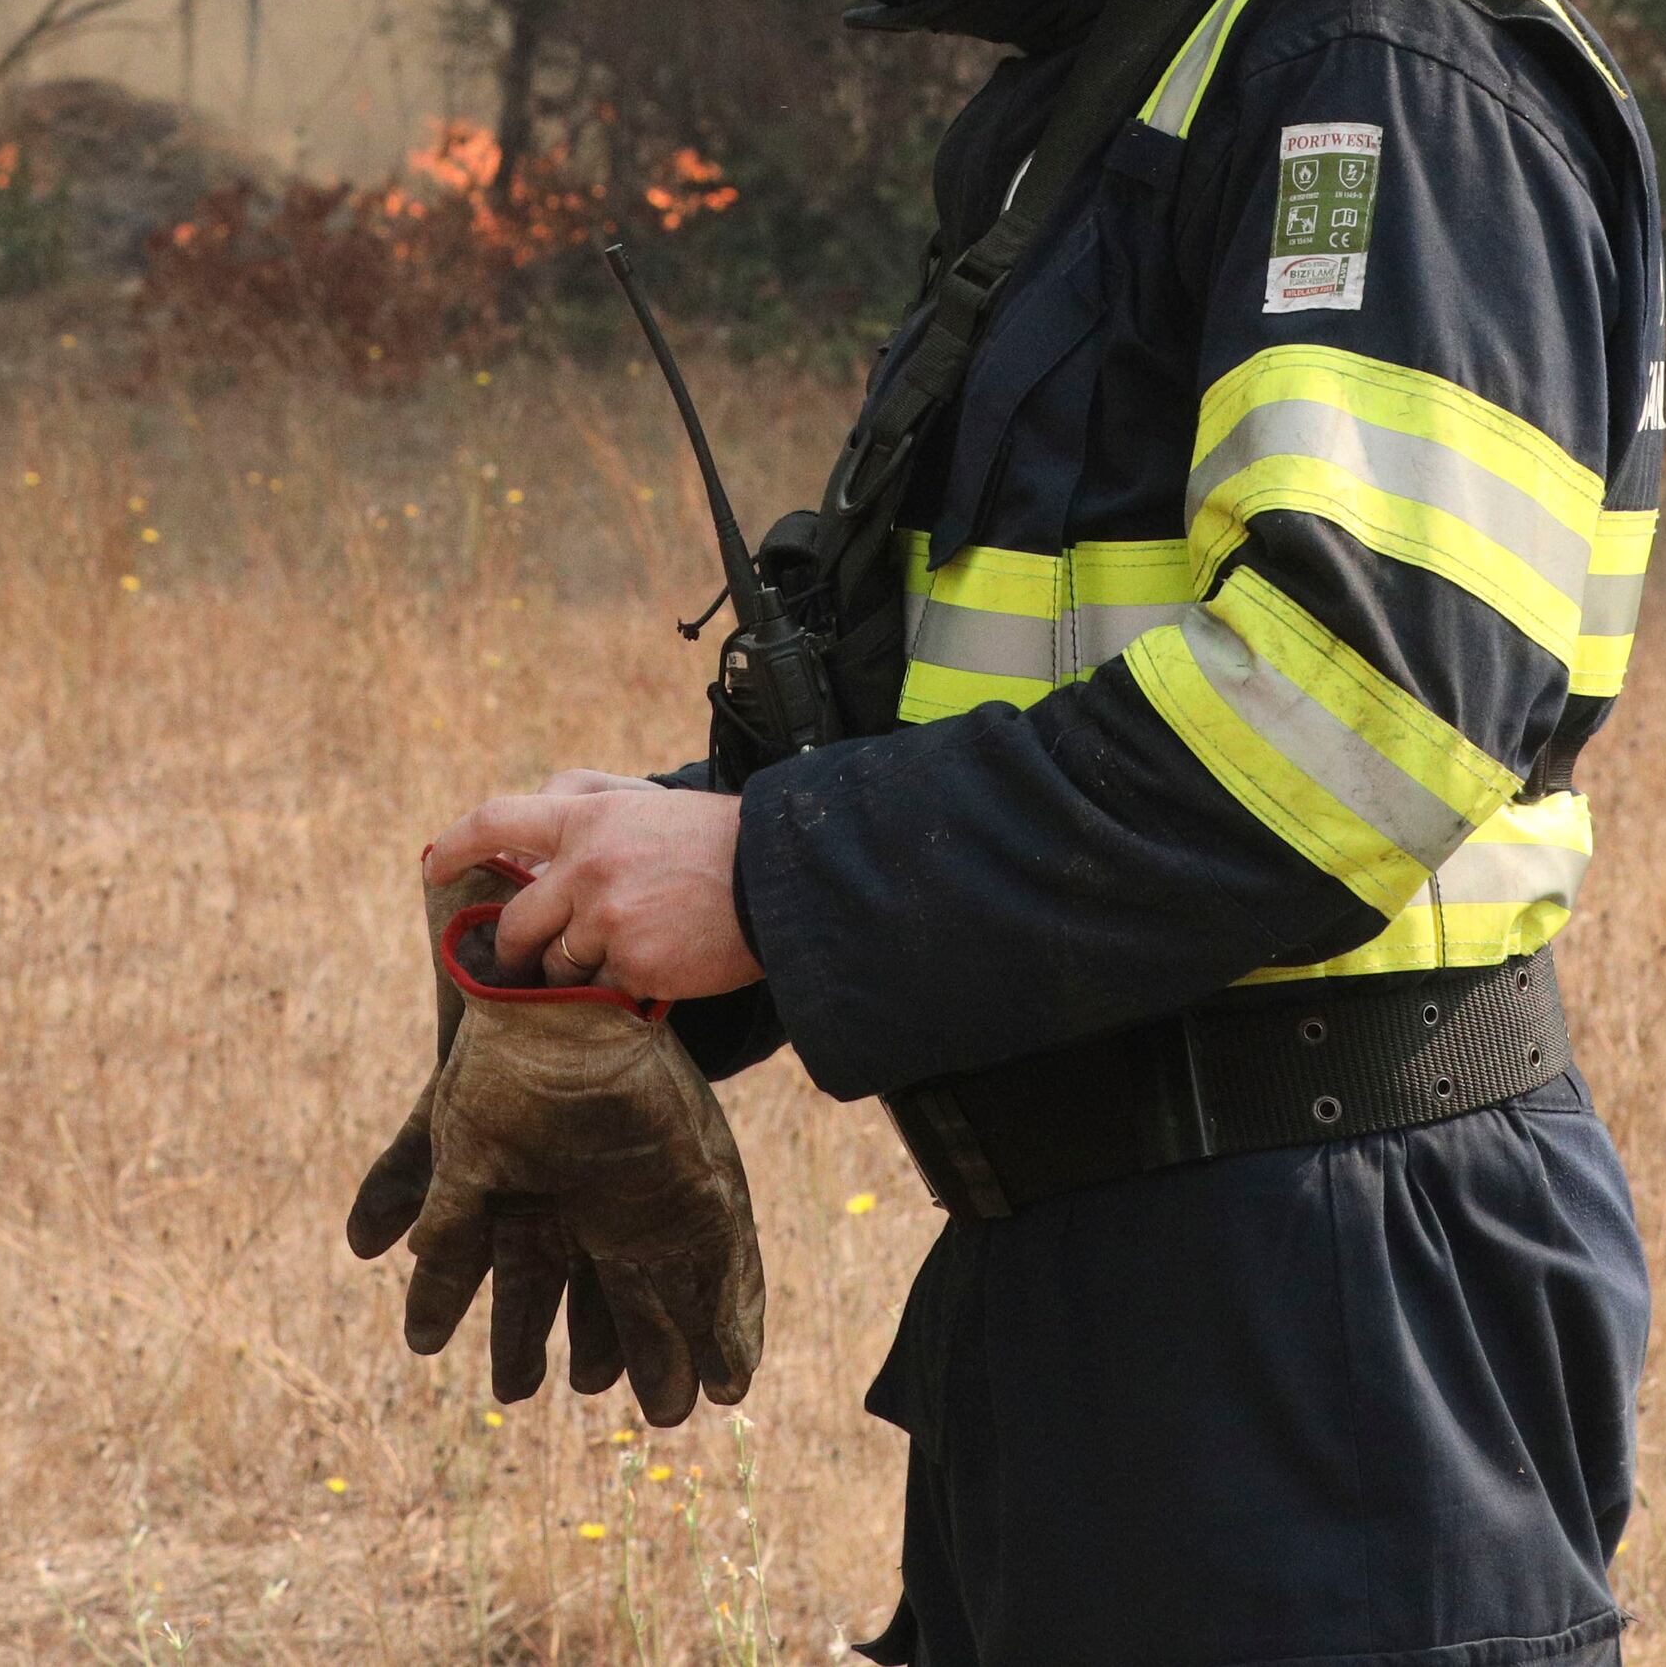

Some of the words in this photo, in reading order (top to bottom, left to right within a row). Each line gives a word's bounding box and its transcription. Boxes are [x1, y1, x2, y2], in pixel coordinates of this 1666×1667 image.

[1287, 133, 1374, 152] PORTWEST
[1290, 268, 1335, 279] BIZFLAME
[1338, 261, 1348, 285] PLUS
[1285, 288, 1319, 297] WILDLAND
